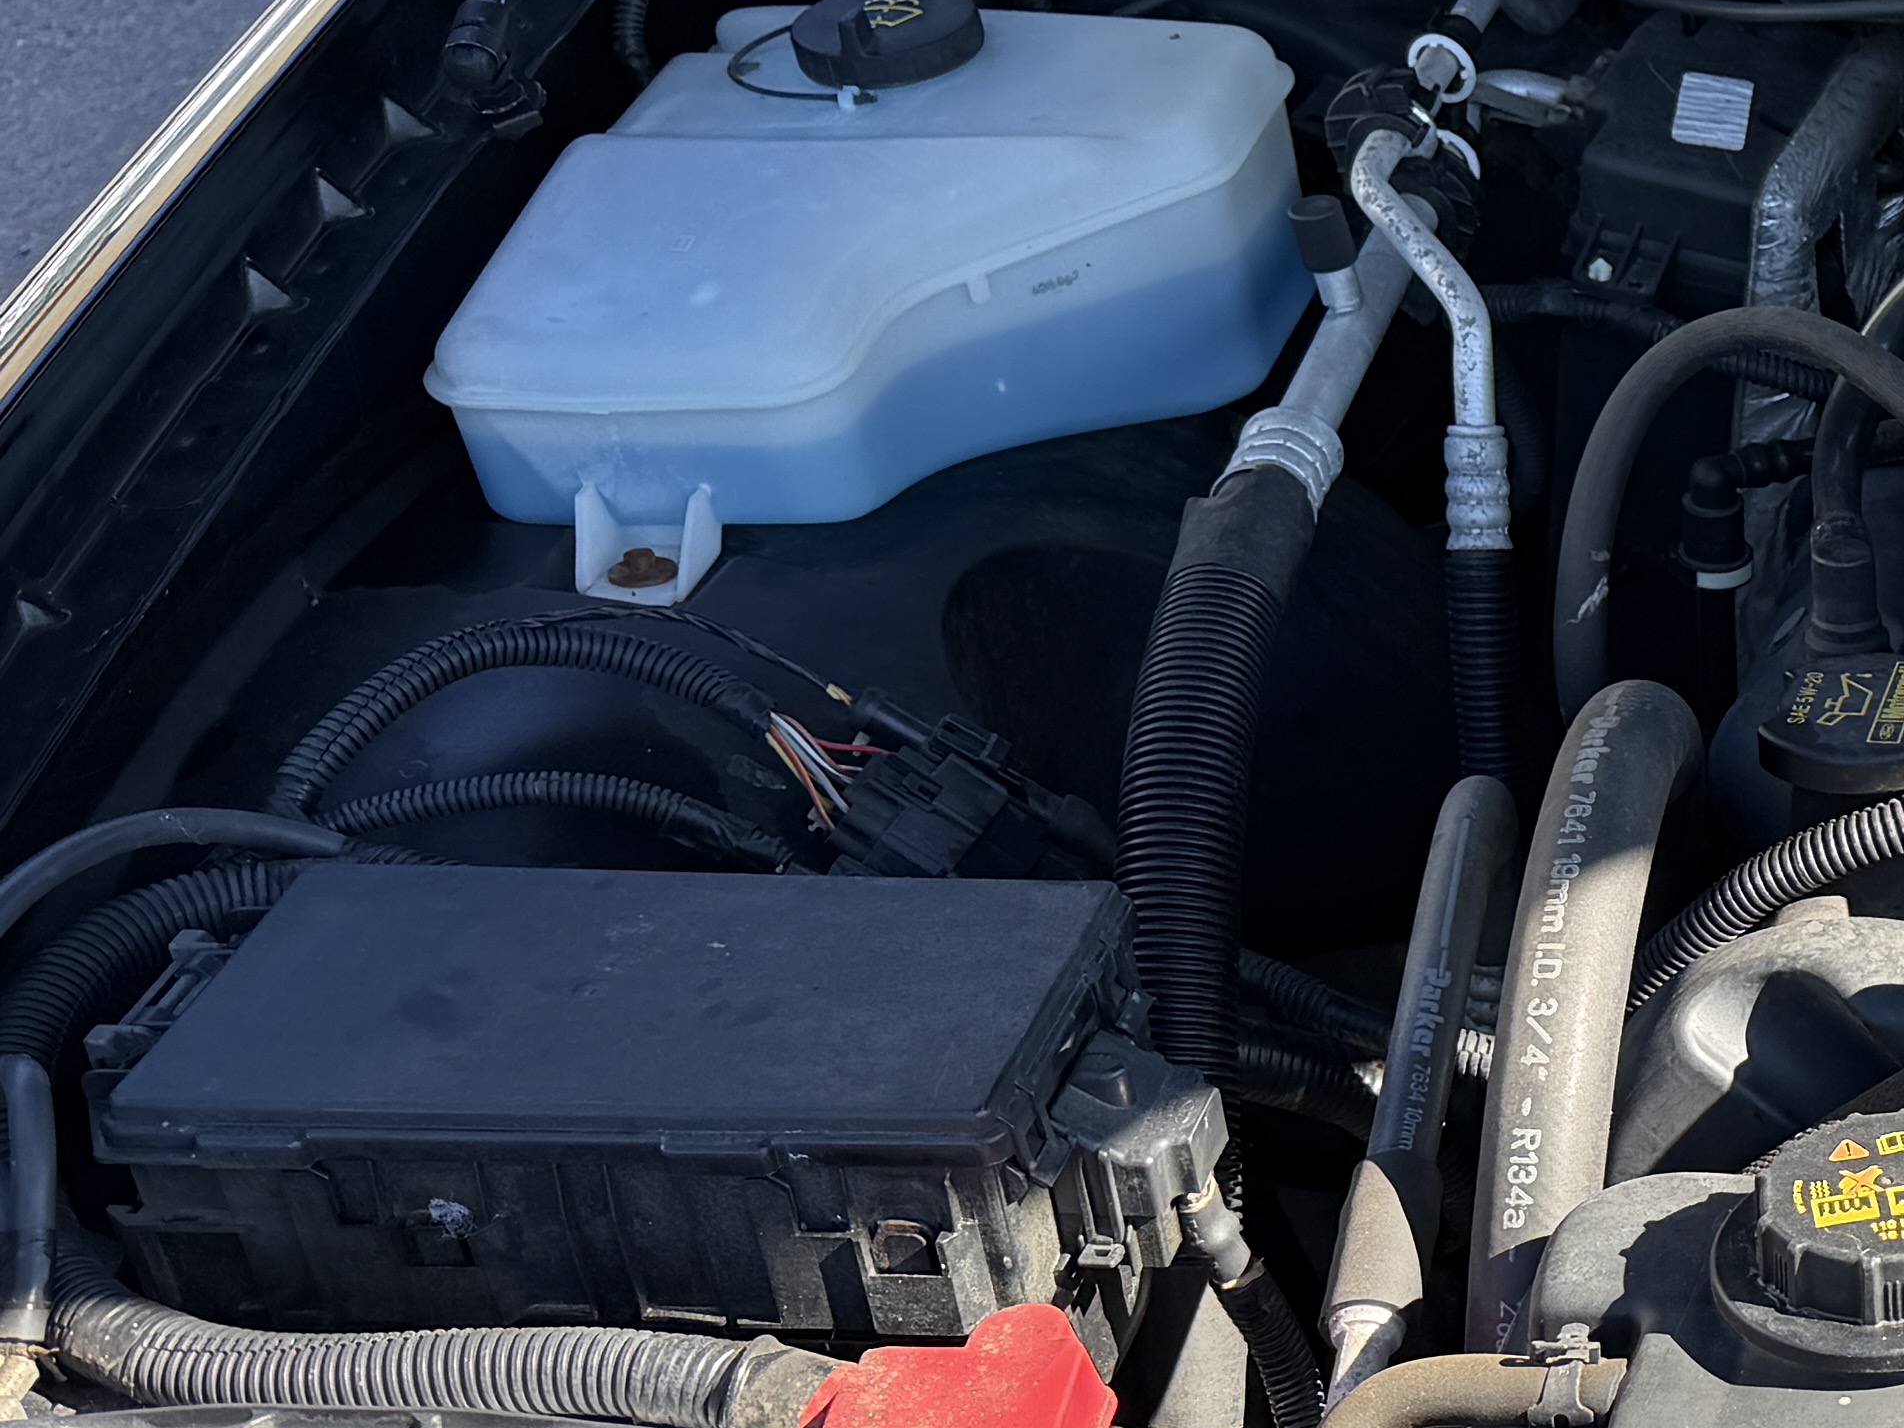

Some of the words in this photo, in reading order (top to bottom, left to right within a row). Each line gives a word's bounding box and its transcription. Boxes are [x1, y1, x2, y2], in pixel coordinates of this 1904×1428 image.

[1798, 672, 1824, 702] 5W-20
[1787, 705, 1811, 725] SAE
[1570, 716, 1621, 786] Parker
[1556, 791, 1599, 845] 7641
[1534, 852, 1582, 933] 19mm
[1410, 967, 1450, 1057] Parker
[1407, 1067, 1431, 1102] 7634
[1400, 1107, 1423, 1151] 10mm
[1502, 1127, 1543, 1231] R134a
[1870, 1219, 1897, 1233] 110
